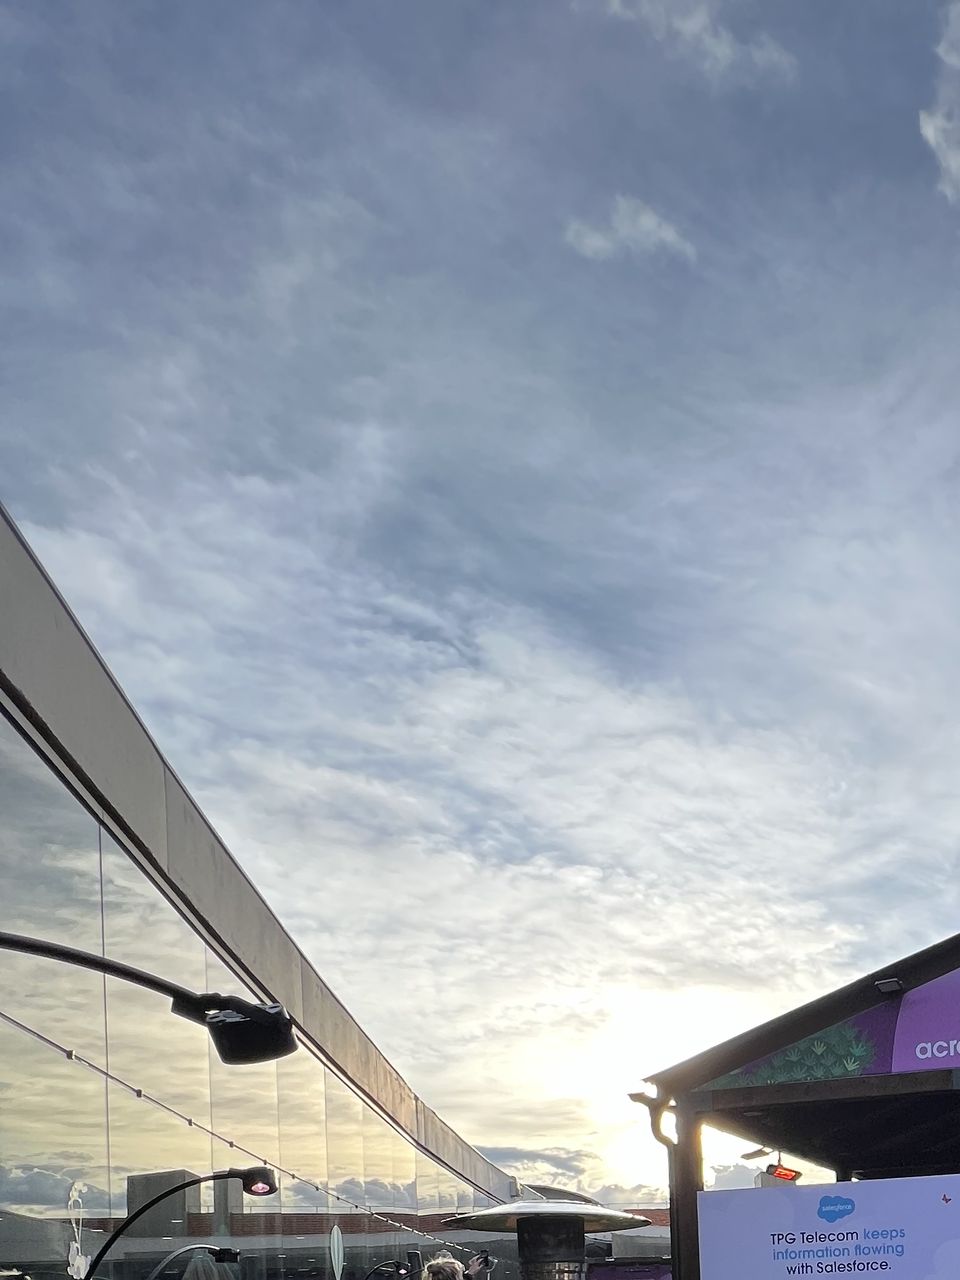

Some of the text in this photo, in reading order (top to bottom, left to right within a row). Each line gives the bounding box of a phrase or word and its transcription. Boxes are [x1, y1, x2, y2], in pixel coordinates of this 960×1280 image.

[770, 1228, 906, 1245] TPG Telecom keeps
[772, 1243, 905, 1261] information flowing
[786, 1259, 892, 1275] with Salesforce.
